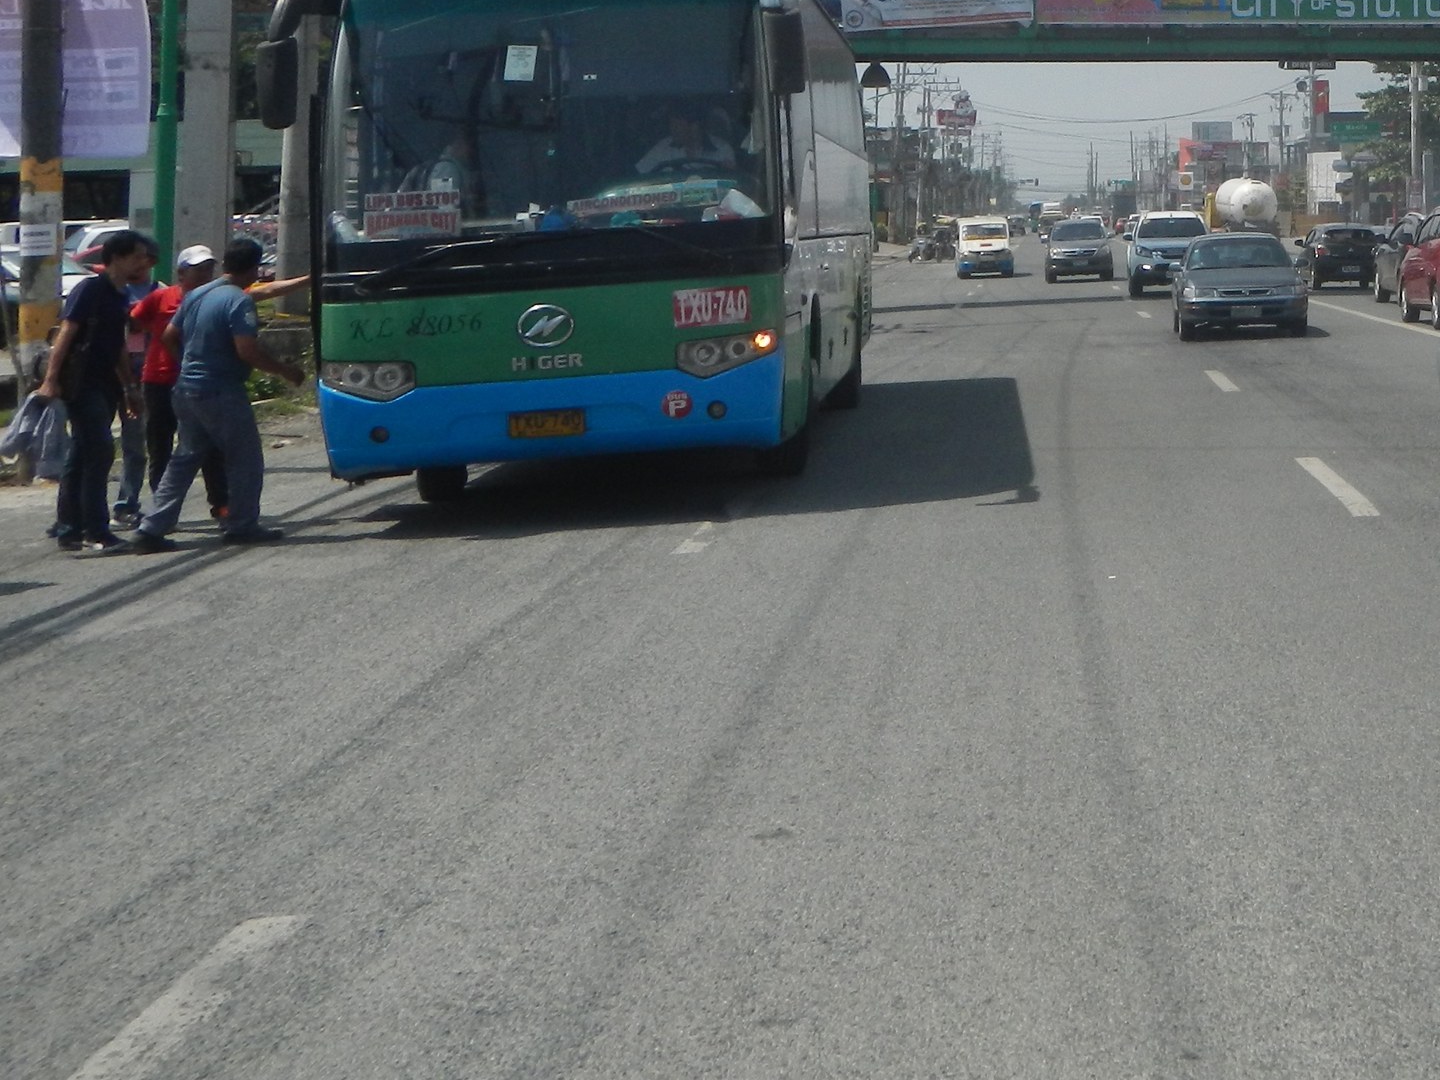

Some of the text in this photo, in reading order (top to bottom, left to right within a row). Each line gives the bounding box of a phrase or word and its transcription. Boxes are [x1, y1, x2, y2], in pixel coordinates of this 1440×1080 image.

[426, 191, 459, 206] STOP
[573, 191, 677, 212] AIRCONDITIONED
[674, 288, 748, 324] TXU-740
[512, 353, 583, 371] HIGER
